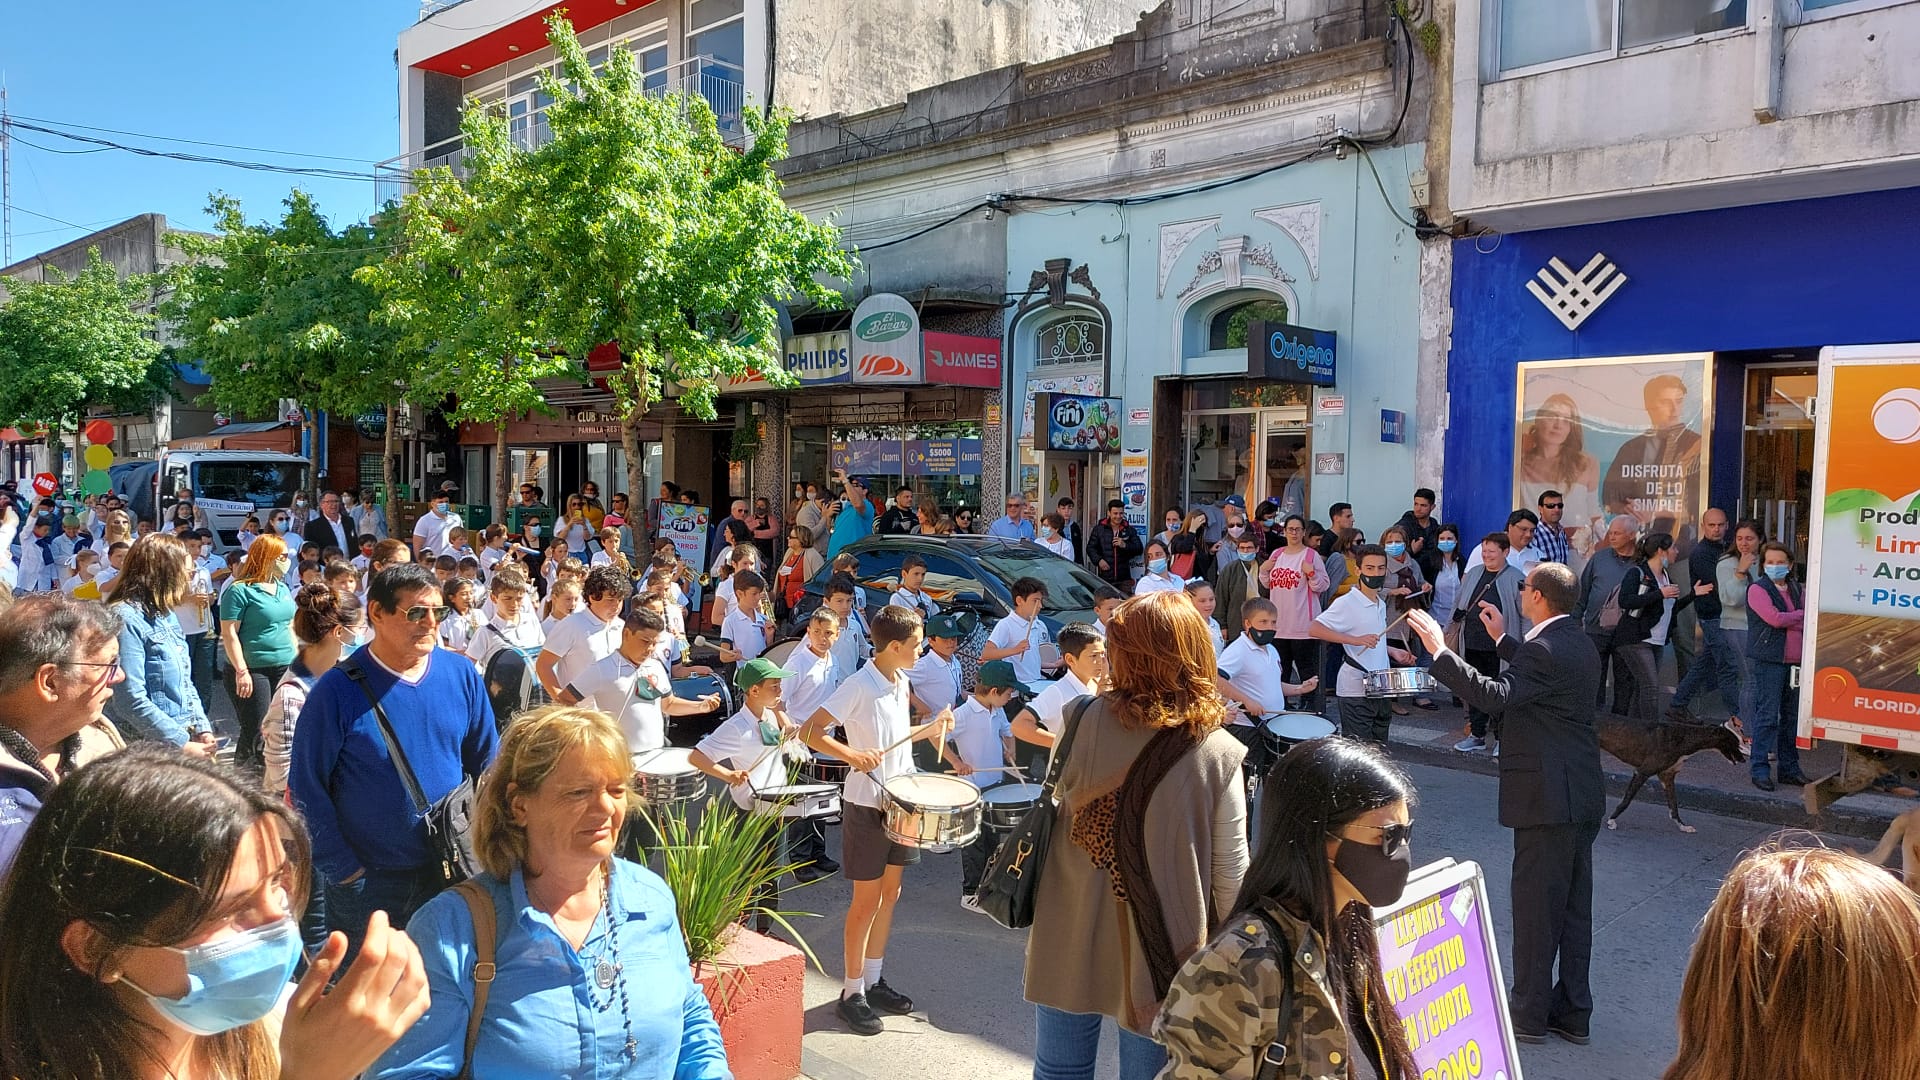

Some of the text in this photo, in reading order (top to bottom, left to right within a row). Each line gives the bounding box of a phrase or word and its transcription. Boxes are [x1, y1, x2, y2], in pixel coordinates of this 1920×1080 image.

[882, 312, 895, 322] El
[866, 320, 908, 334] Bazar
[1270, 331, 1334, 369] Oxigeno
[788, 348, 848, 371] PHILIPS
[945, 351, 998, 369] JAMES
[577, 411, 596, 423] CLUB
[1621, 461, 1684, 478] DISFRUTÁ
[36, 476, 55, 491] PARE
[1123, 485, 1146, 494] OREO
[1646, 481, 1683, 495] DE LO
[226, 503, 254, 512] SEGURO
[1633, 498, 1683, 513] SIMPLE
[665, 531, 699, 541] Golosinas
[1872, 562, 1920, 581] Aro
[1391, 893, 1447, 948] LLEVATE
[1383, 934, 1466, 1006] TU EFECTIVO
[1418, 1007, 1430, 1043] 1
[1428, 983, 1473, 1037] CUOTA
